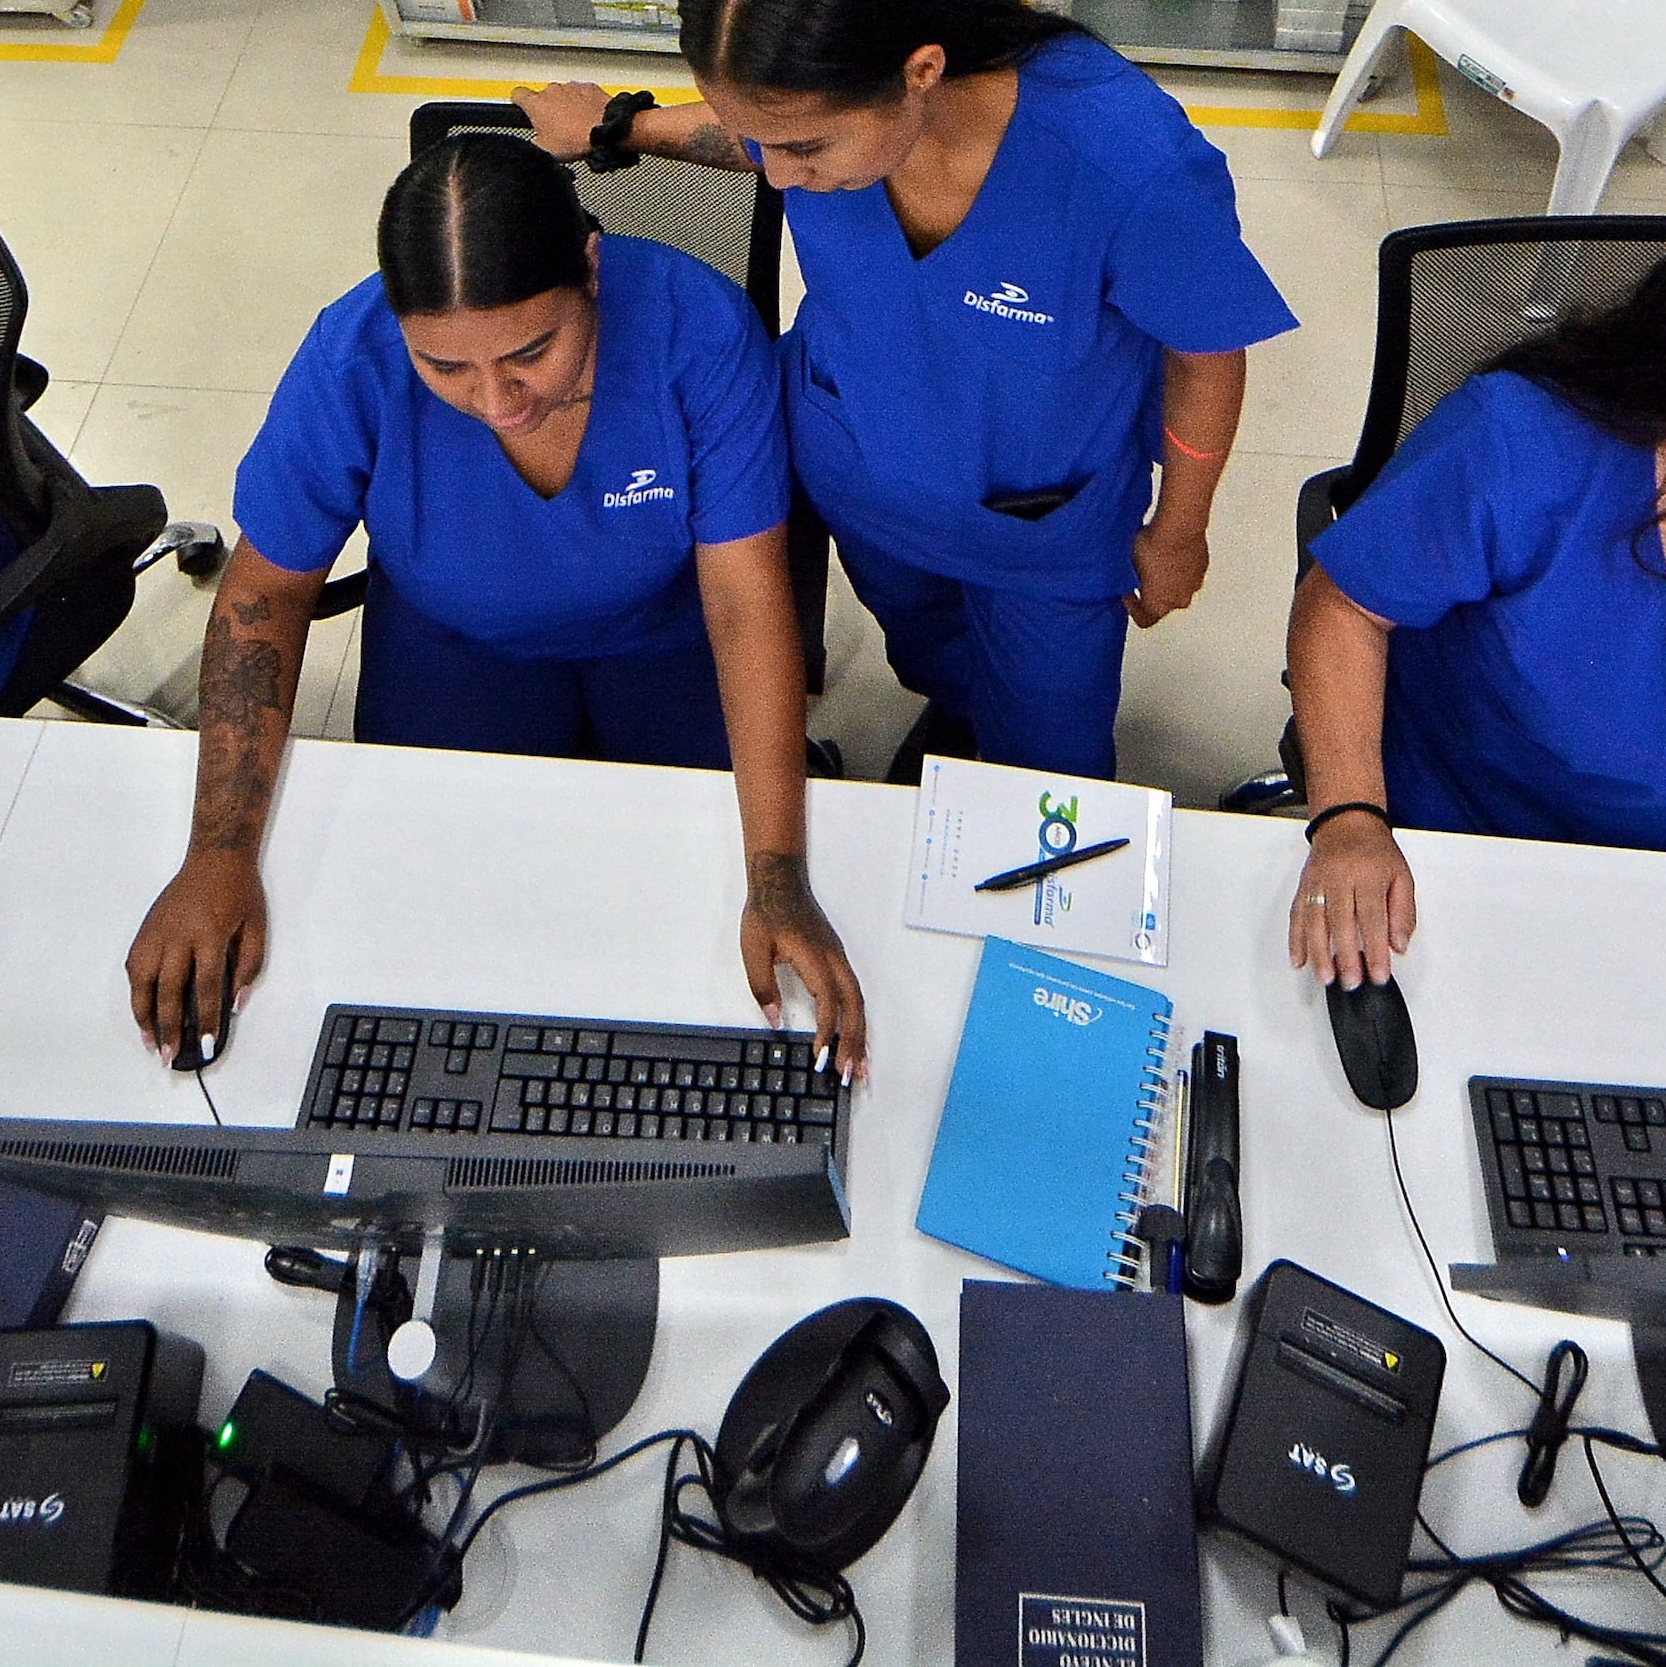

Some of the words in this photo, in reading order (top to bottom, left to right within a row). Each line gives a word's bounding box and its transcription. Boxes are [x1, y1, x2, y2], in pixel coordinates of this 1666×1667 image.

[964, 291, 1046, 325] Disfarma
[603, 485, 675, 509] Disfarma
[1038, 789, 1078, 857] 30
[1034, 987, 1093, 1026] Shire
[1288, 1442, 1326, 1477] SAT
[1052, 1609, 1110, 1628] INGLES
[1113, 1614, 1135, 1629] DE
[1029, 1629, 1136, 1651] DICCIONARIO
